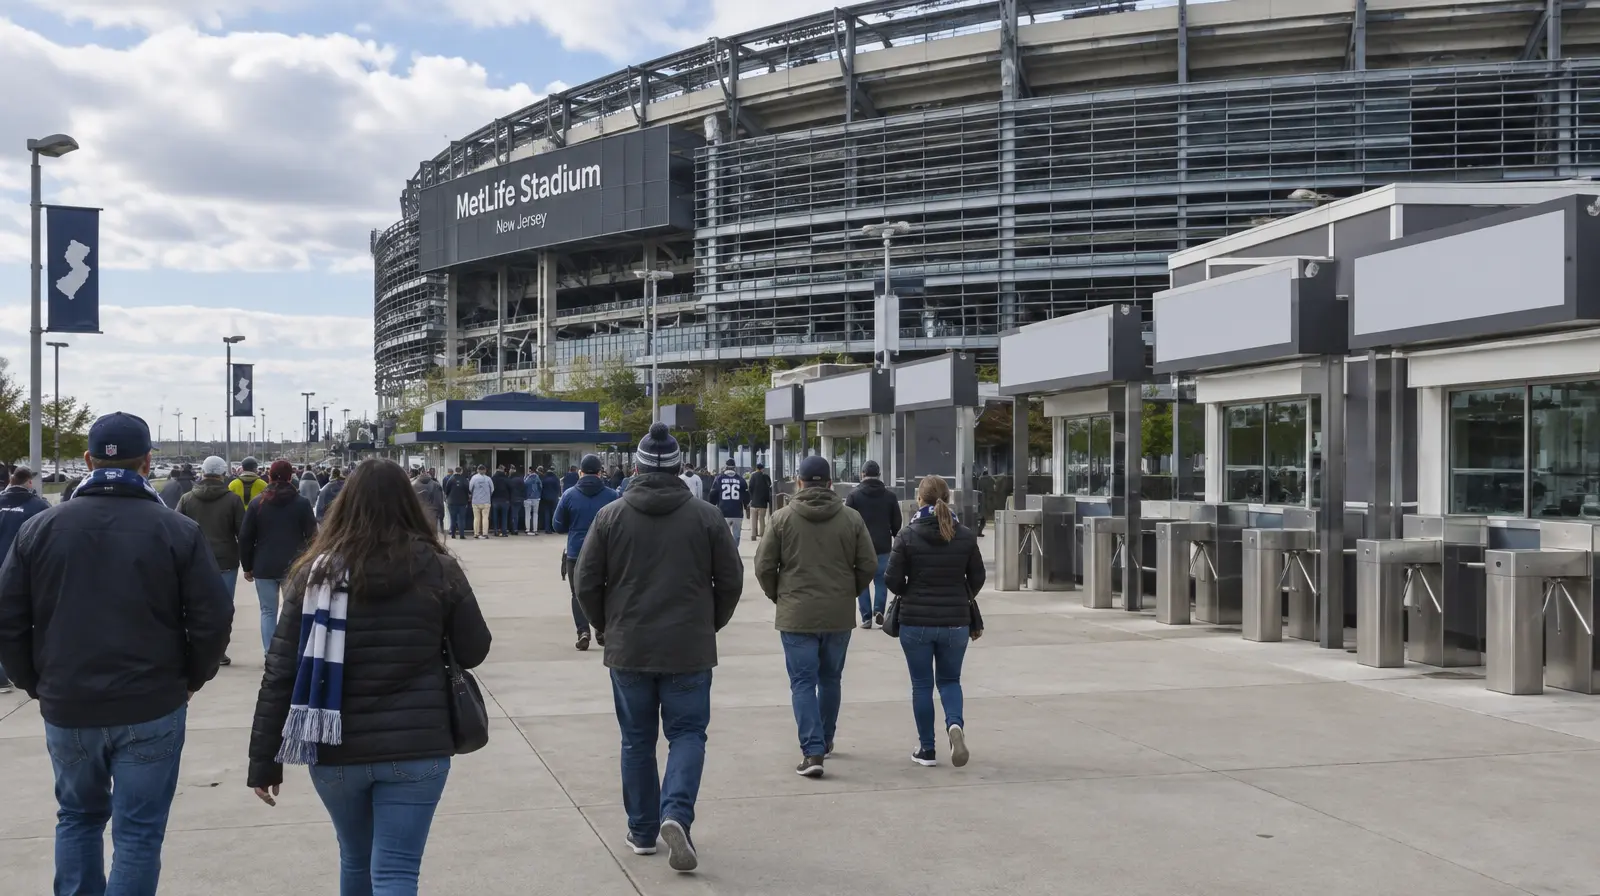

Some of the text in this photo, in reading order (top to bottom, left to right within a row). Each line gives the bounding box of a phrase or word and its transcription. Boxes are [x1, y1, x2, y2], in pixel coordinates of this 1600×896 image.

[456, 163, 601, 220] MetLife Stadium
[496, 212, 547, 234] New Jersey
[721, 483, 740, 500] 26
